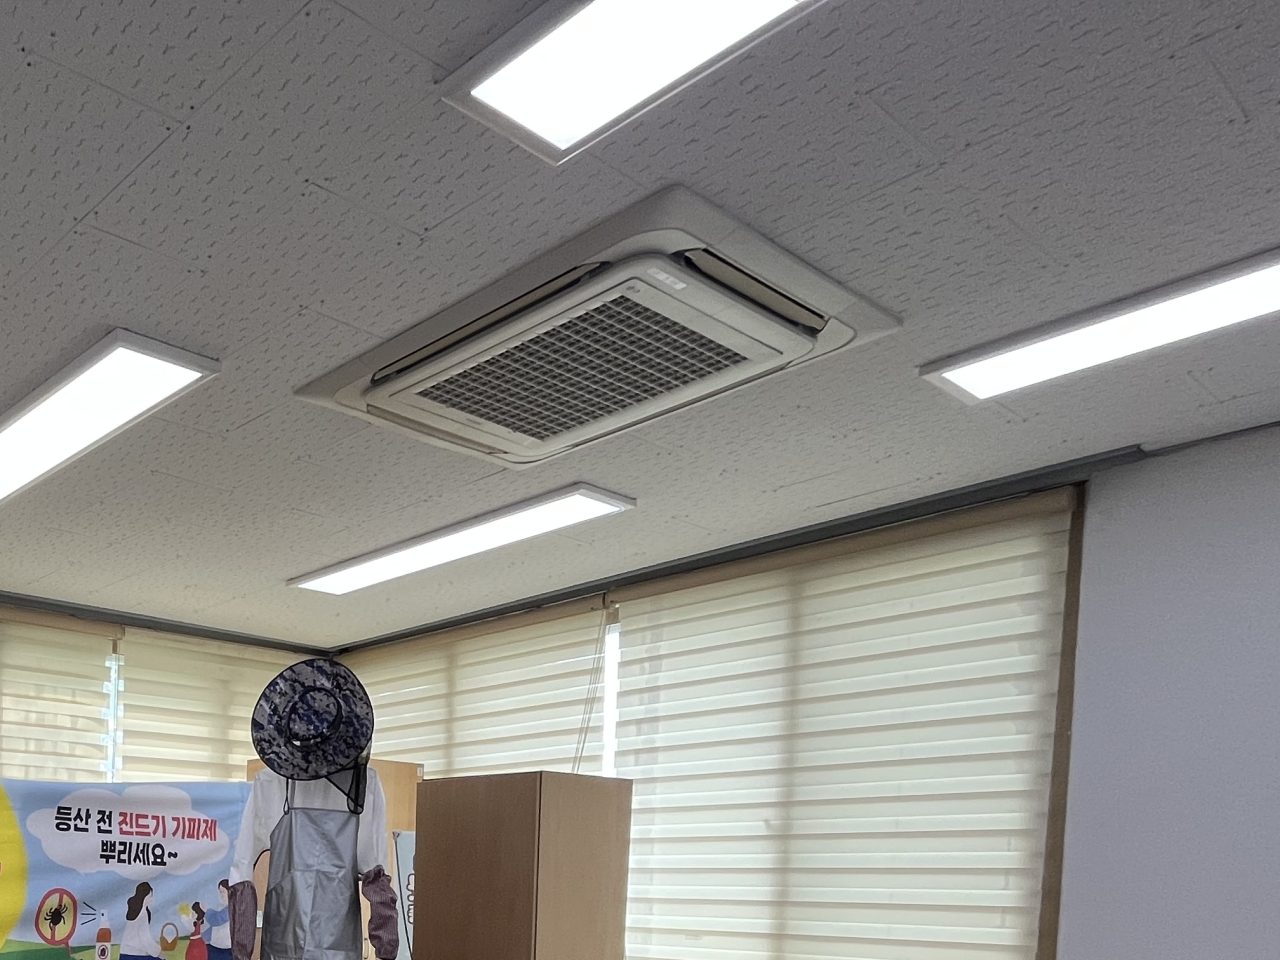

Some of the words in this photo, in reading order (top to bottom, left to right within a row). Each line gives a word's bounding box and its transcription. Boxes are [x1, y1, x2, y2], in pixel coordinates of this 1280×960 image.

[54, 805, 91, 833] 등산
[96, 809, 114, 834] 전
[118, 811, 167, 838] 진드기
[171, 816, 217, 842] 기피제
[99, 841, 178, 868] 뿌리세요~
